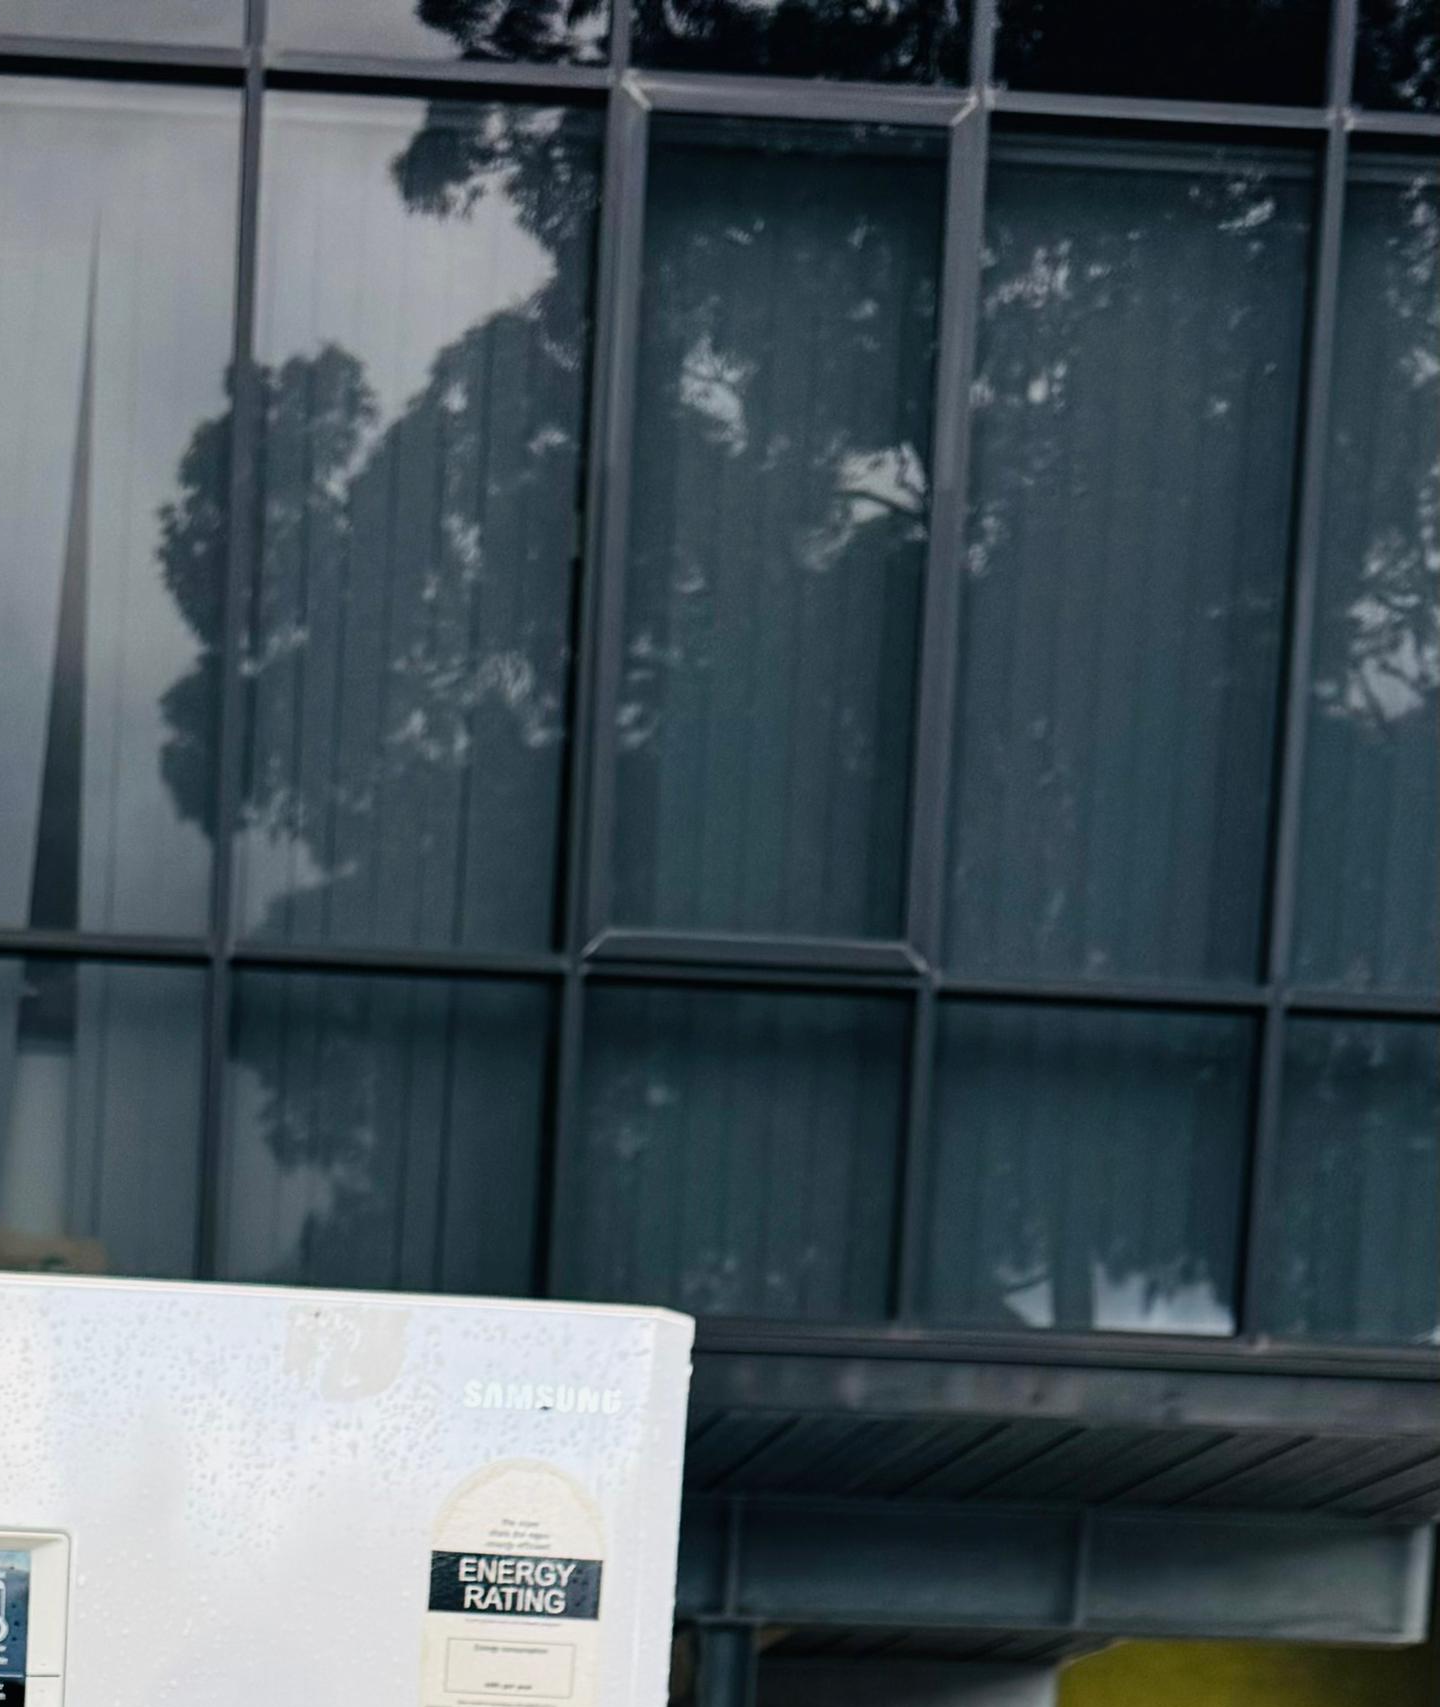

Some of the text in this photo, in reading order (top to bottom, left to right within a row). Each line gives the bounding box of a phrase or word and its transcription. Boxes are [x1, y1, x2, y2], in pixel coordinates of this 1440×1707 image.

[463, 1379, 623, 1415] SAMSUNG
[459, 1556, 576, 1588] ENERGY
[463, 1584, 566, 1615] RATING
